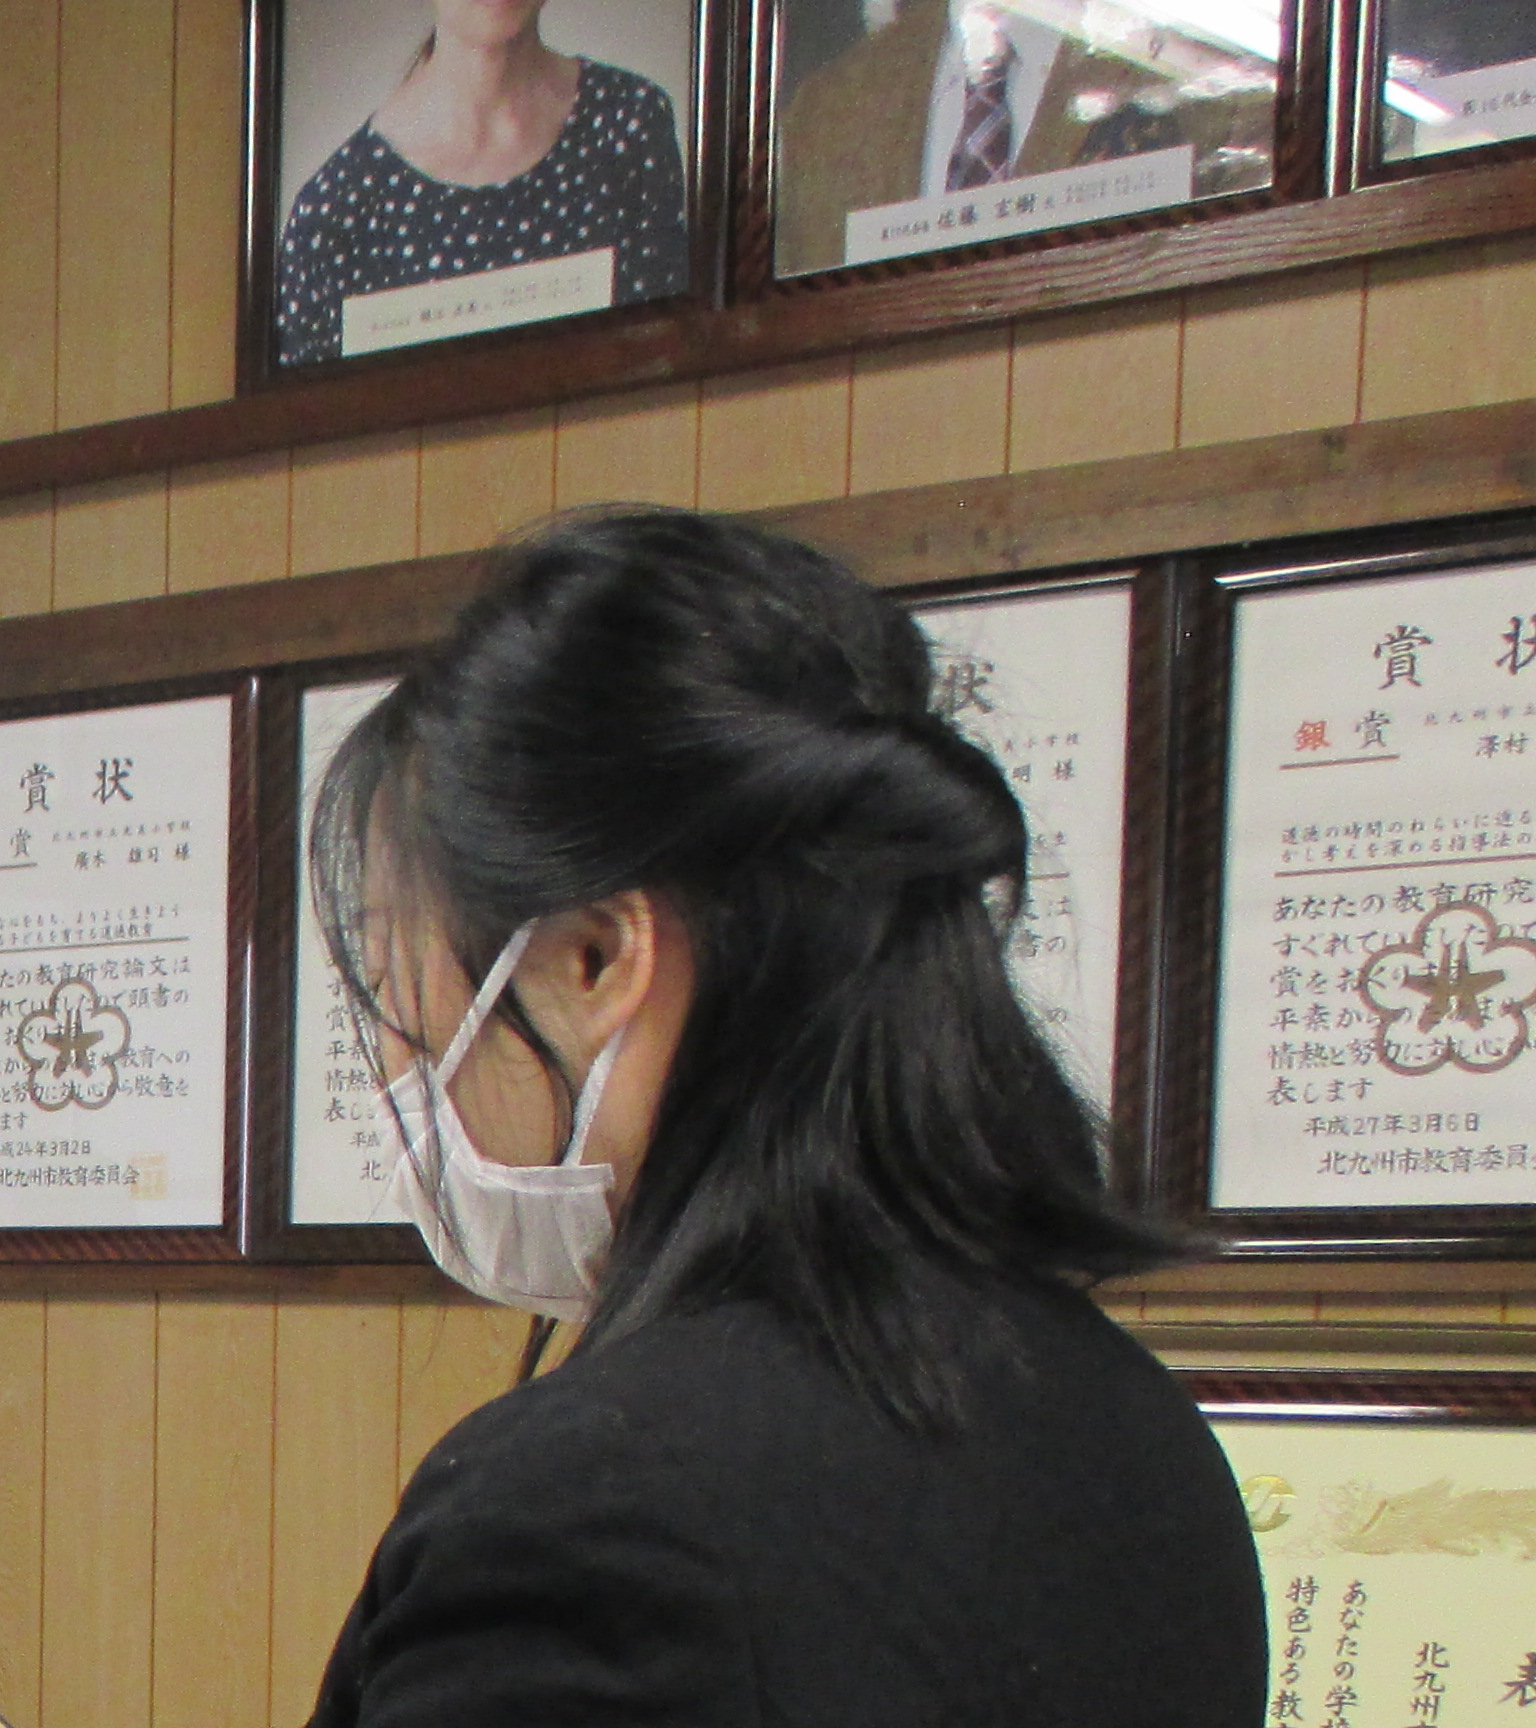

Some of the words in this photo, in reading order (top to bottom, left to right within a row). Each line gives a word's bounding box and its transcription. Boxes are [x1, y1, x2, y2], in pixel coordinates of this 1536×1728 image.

[1294, 710, 1392, 752] 銀賞
[19, 756, 135, 814] 賞状
[1273, 876, 1535, 922] あなたの教育研究
[1267, 1075, 1373, 1106] 表します
[1303, 1112, 1480, 1138] 平成27年3月6日
[1316, 1143, 1536, 1177] 北九州市教育委員
